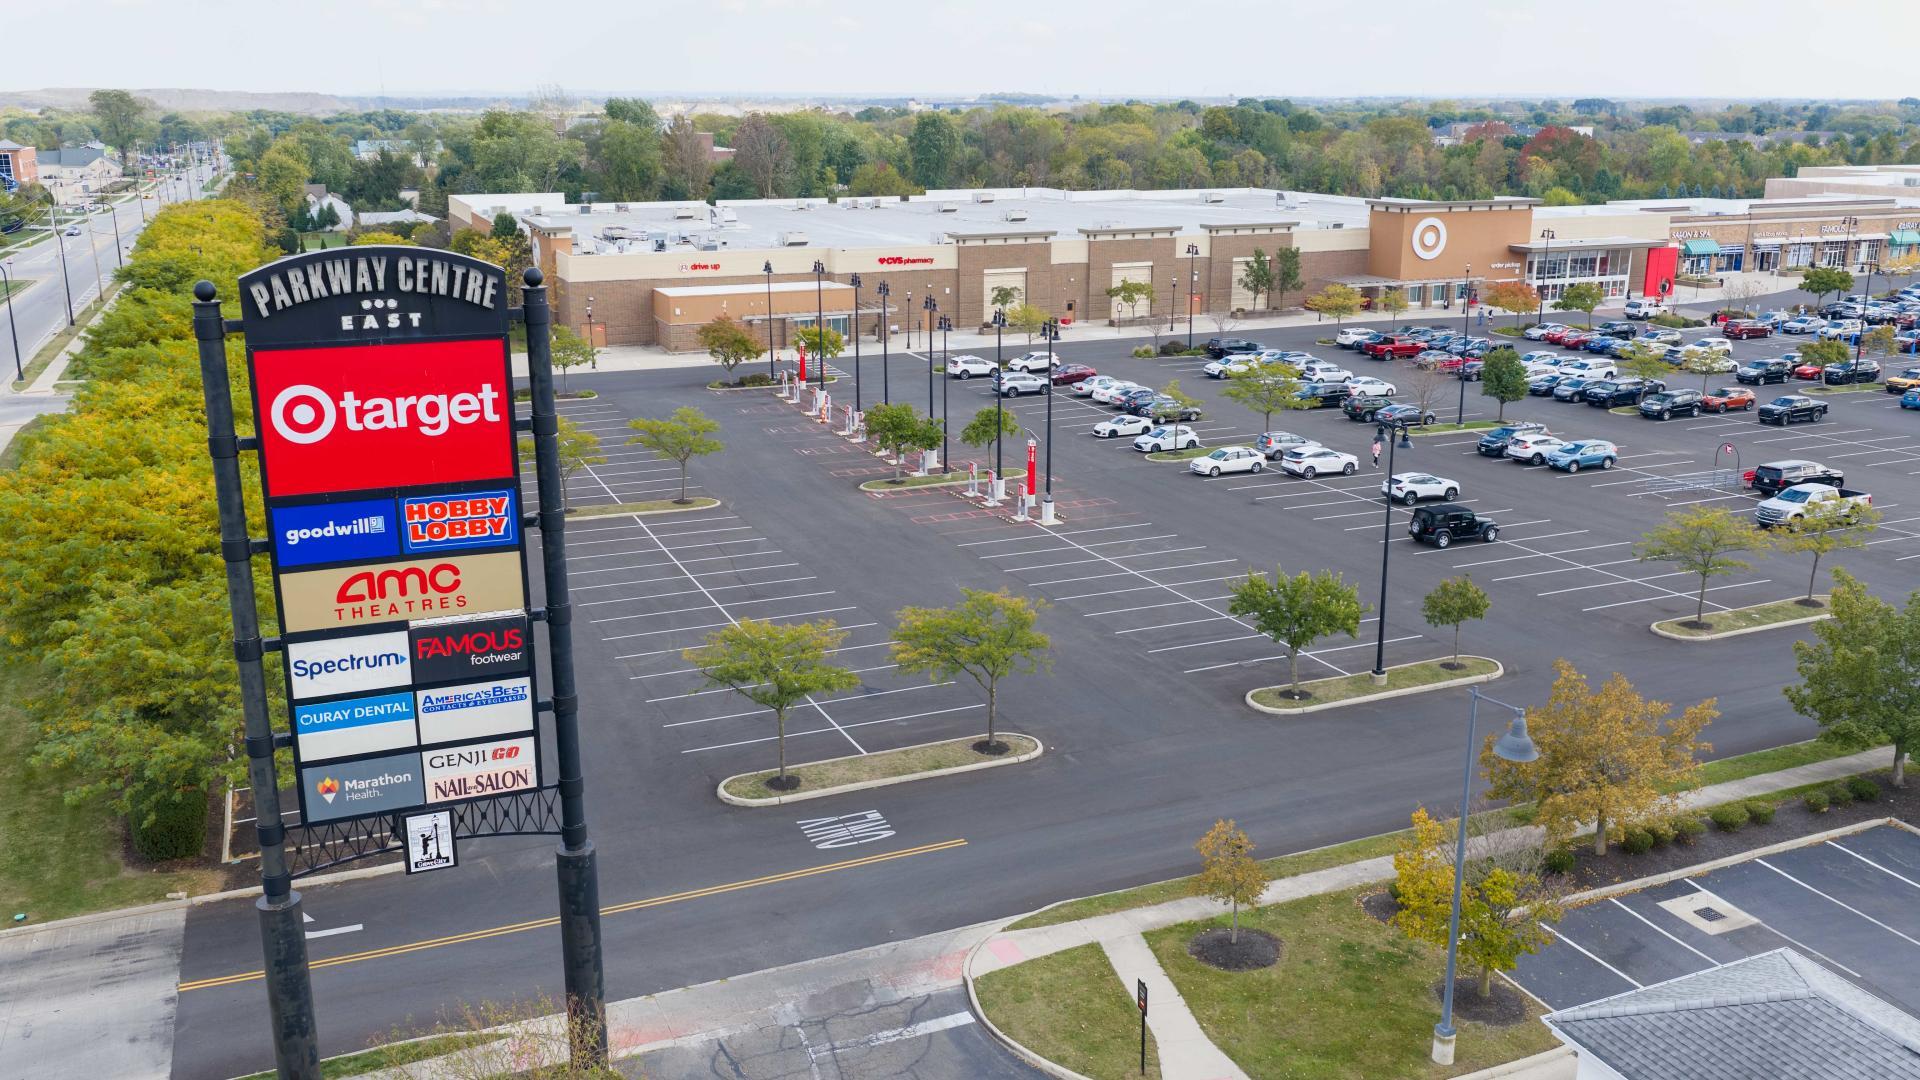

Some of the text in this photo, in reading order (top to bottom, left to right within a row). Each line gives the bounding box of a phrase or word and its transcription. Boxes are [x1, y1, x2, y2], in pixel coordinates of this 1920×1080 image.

[1821, 225, 1846, 233] FAMOUS
[690, 262, 721, 271] drive up
[886, 256, 934, 266] CVS pharmacy
[250, 256, 499, 318] PARKWAY CENTRE
[341, 312, 422, 331] EAST
[339, 383, 500, 436] target
[405, 497, 509, 523] HOBBY
[286, 517, 370, 545] goodwill
[410, 517, 508, 542] LOBBY
[334, 595, 467, 621] THEATRES
[417, 628, 523, 660] FAMOUS
[293, 652, 400, 680] Spectrum
[470, 652, 522, 666] footwear
[300, 702, 410, 726] OURAY DENTAL
[423, 701, 467, 713] CONTACTS
[476, 694, 526, 706] EYEGLASSES
[429, 746, 519, 769] GENJI GO
[344, 772, 412, 792] Marathon
[434, 777, 470, 799] NAIL
[475, 768, 529, 794] SALON
